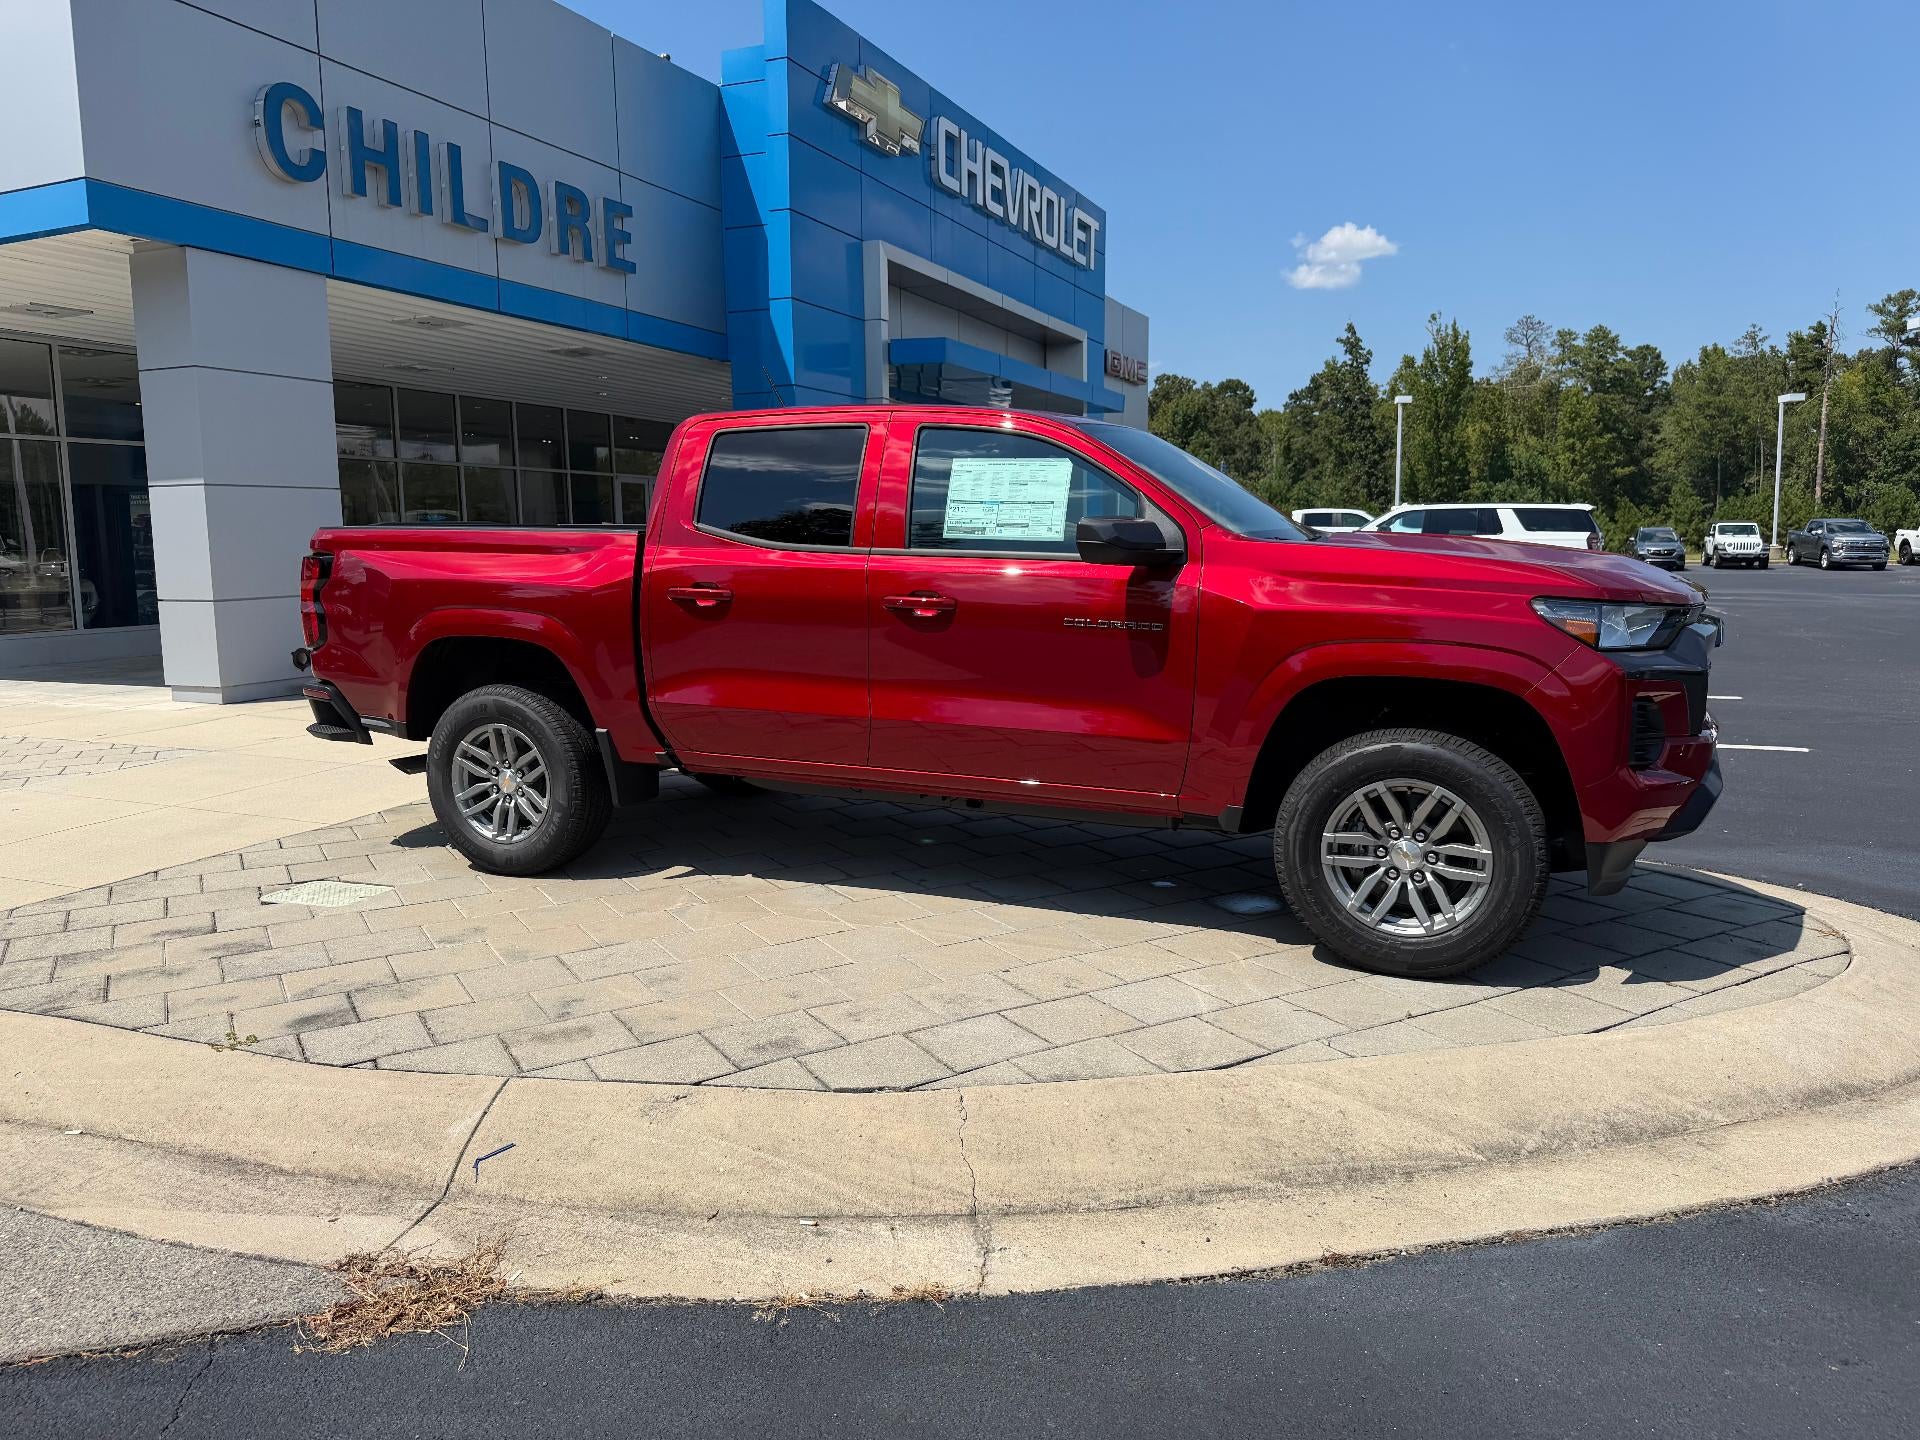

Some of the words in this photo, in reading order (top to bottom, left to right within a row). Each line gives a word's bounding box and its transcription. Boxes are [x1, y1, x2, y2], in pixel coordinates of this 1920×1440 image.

[254, 81, 636, 275] CHILDRE
[931, 115, 1100, 271] CHEVROLET
[1107, 350, 1148, 386] GMC
[1063, 617, 1164, 631] COLORADO
